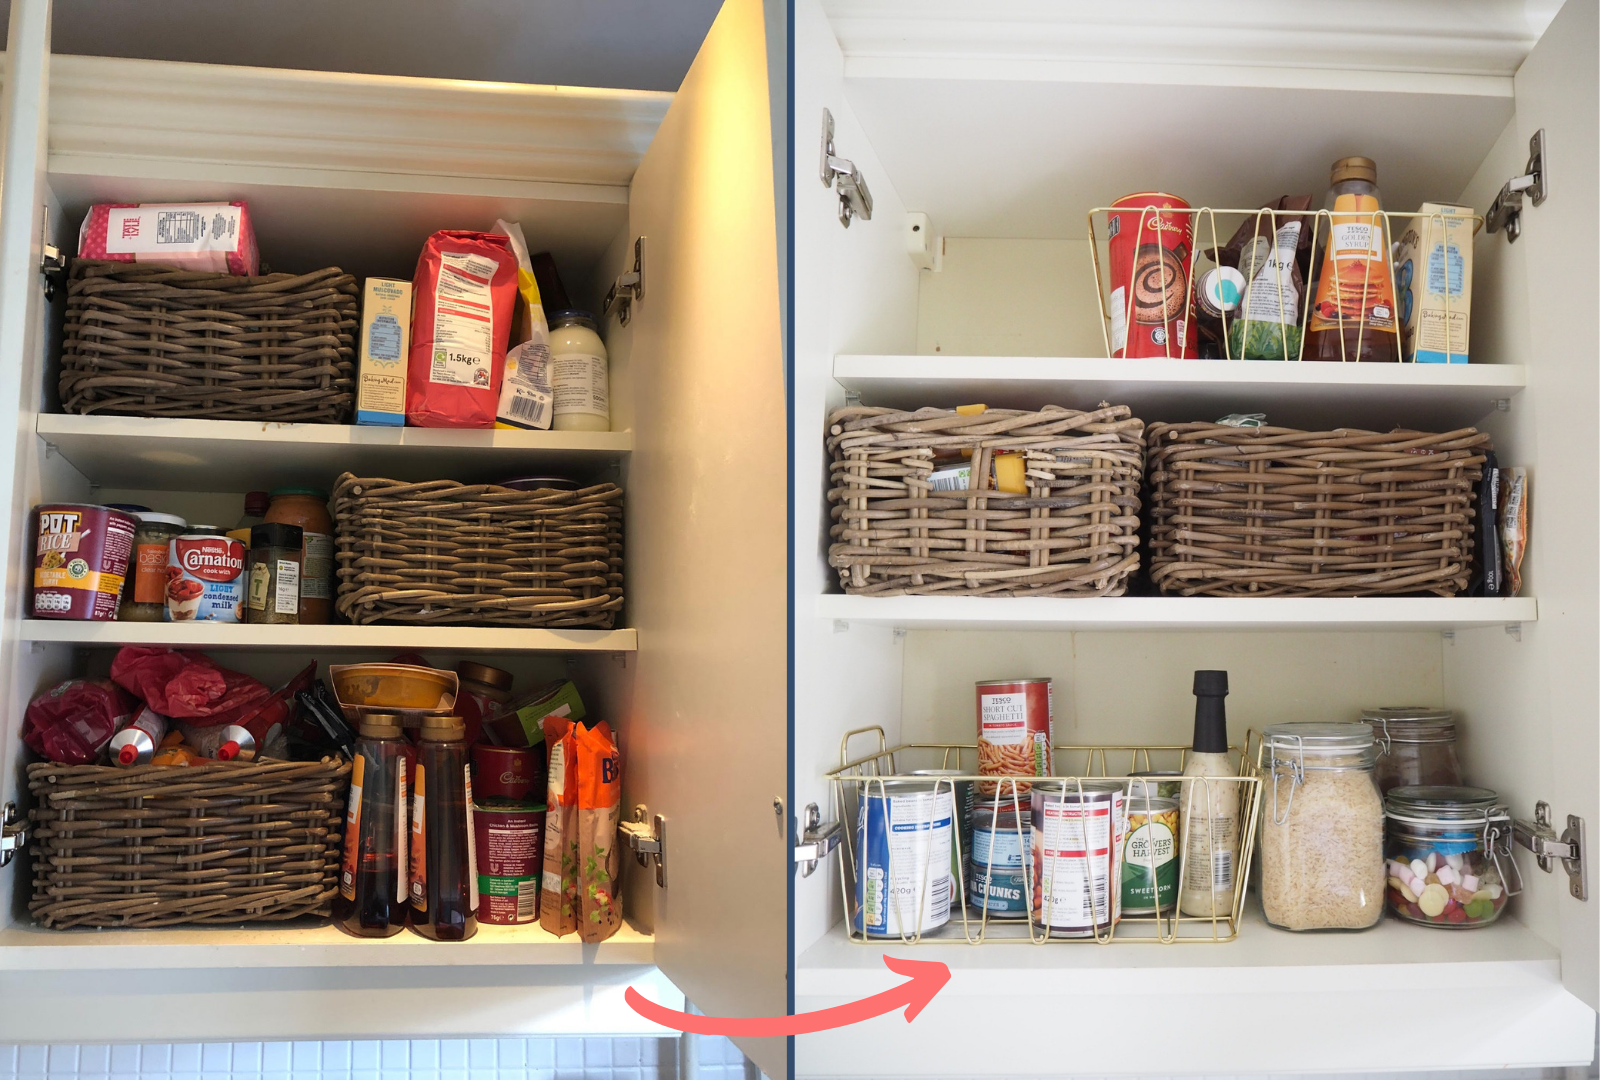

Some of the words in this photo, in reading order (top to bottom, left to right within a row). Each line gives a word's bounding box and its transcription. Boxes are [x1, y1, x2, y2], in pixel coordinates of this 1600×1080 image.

[1147, 216, 1182, 236] Cadbury
[1268, 259, 1285, 271] 1kg
[449, 353, 472, 366] 1.5kg
[40, 513, 79, 535] POT
[40, 533, 72, 551] RICE
[183, 549, 243, 571] Carnation
[210, 584, 235, 593] LIGHT
[203, 593, 239, 602] condensed
[211, 601, 233, 609] milk
[983, 705, 1005, 714] SHORT
[1006, 705, 1023, 713] CUT
[983, 713, 1023, 721] SPAGHETTI
[1131, 838, 1172, 850] GROWER'S
[1133, 847, 1171, 857] HARVEST
[1130, 884, 1171, 895] SWEETORN
